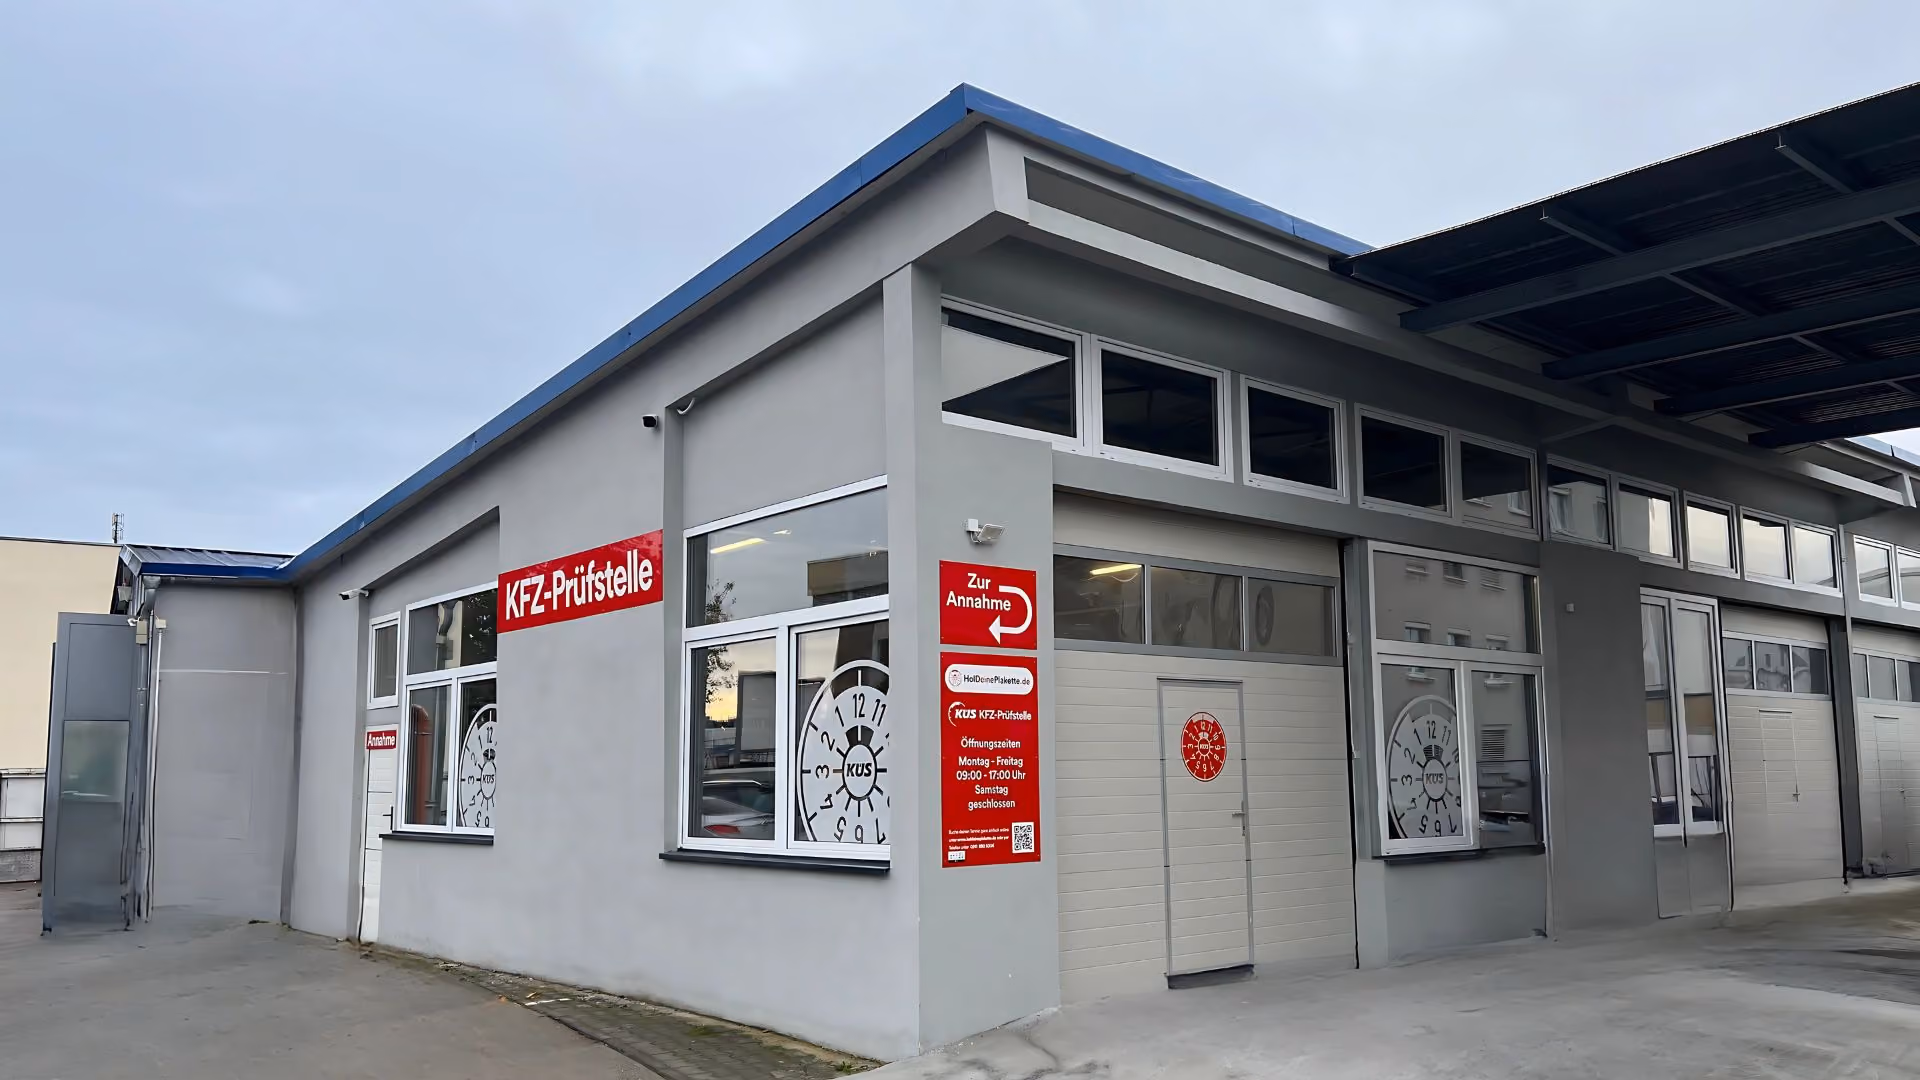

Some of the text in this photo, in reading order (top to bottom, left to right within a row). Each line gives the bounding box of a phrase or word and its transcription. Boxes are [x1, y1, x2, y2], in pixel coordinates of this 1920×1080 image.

[505, 549, 653, 620] KFZ-Prüfstelle
[967, 572, 991, 589] Zur
[946, 590, 1011, 611] Annahme
[852, 692, 866, 719] 12
[978, 710, 1032, 721] KFZ-Prüfstelle
[486, 726, 494, 744] 12
[1426, 720, 1437, 739] 12
[367, 732, 396, 747] Annahme
[820, 731, 836, 752] 2
[960, 736, 1021, 750] Öffnungszeiten
[958, 756, 990, 768] Montag
[996, 757, 1023, 767] Freitag
[815, 764, 830, 779] 3
[846, 762, 873, 778] KÜS
[956, 770, 982, 781] 09:00
[988, 770, 1010, 780] 17:00
[1012, 770, 1026, 780] Uhr
[975, 784, 1008, 796] Samstag
[968, 798, 1015, 812] geschlossen
